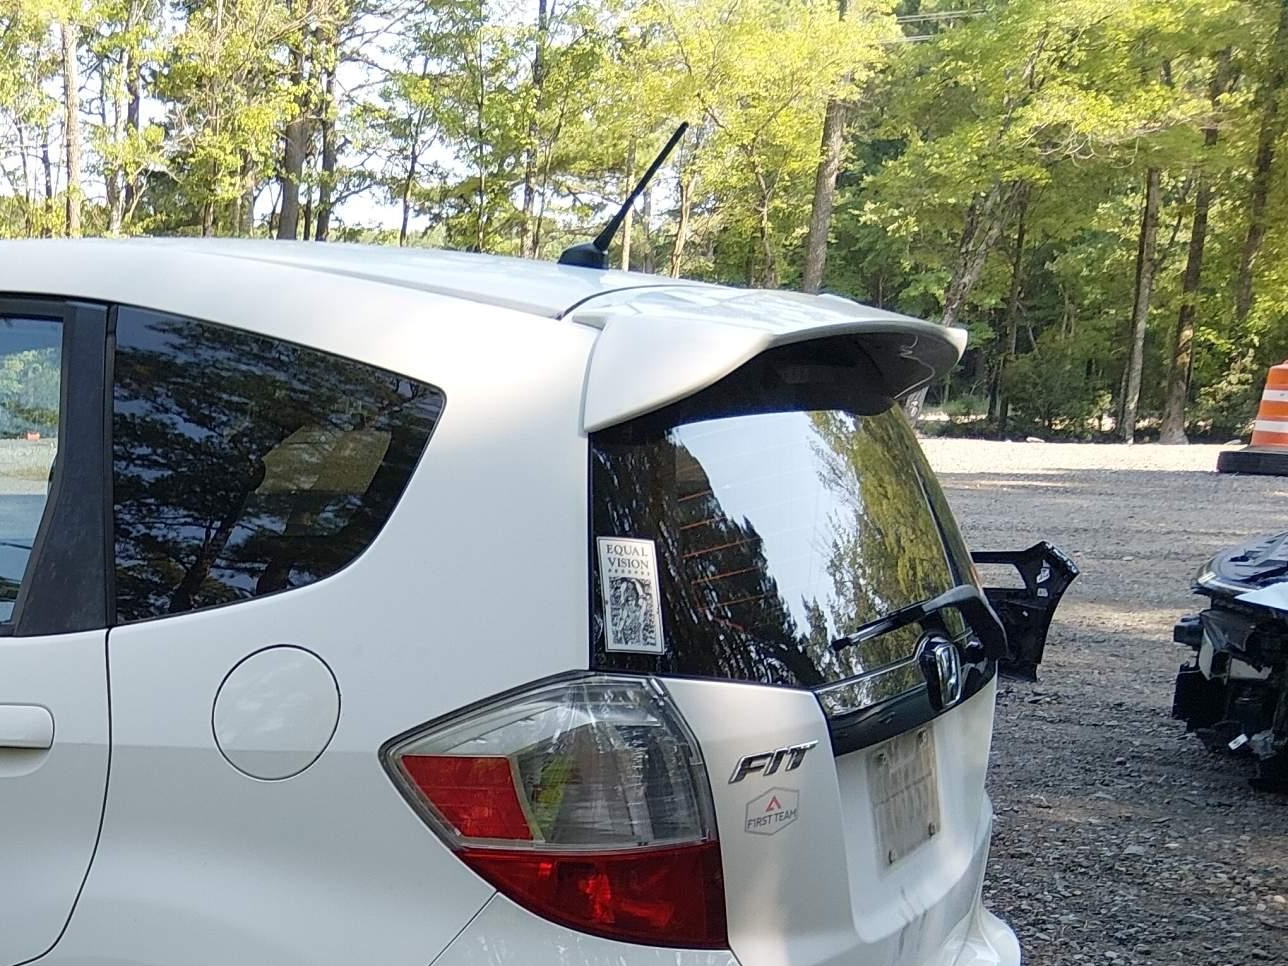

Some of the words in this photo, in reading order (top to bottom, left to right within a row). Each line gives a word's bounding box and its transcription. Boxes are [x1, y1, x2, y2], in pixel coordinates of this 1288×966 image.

[606, 544, 648, 556] EQUAL
[608, 557, 649, 570] VISION
[728, 740, 818, 785] FIT
[747, 815, 772, 829] FIRST
[774, 808, 798, 823] TEAM
